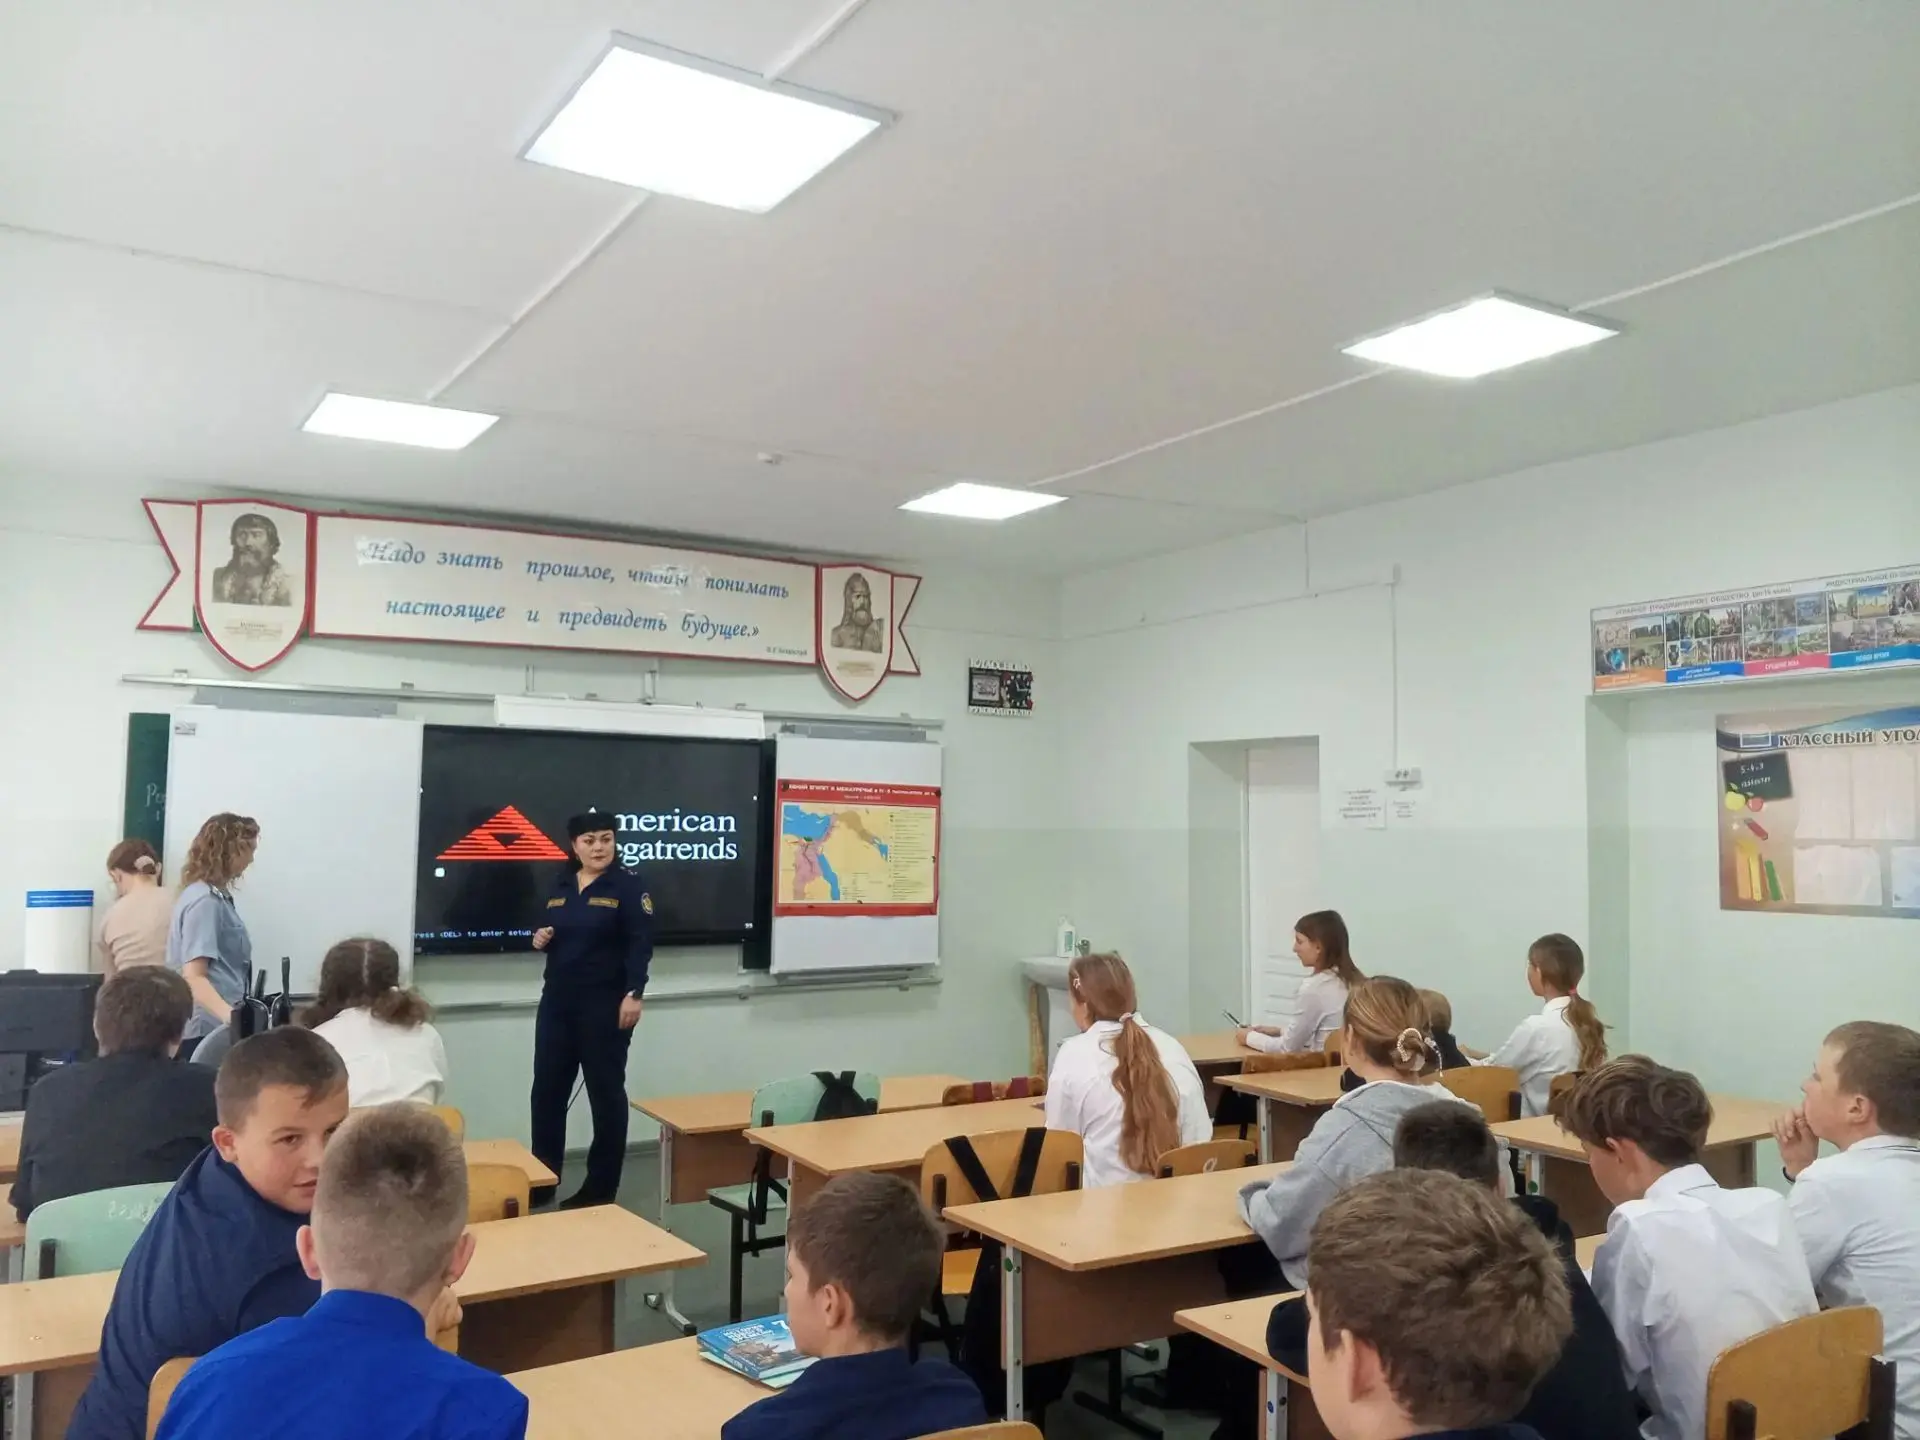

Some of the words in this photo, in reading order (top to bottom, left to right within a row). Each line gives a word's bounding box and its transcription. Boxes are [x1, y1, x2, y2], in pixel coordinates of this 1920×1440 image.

[436, 551, 504, 571] знать
[526, 559, 615, 584] прошлое,
[705, 576, 790, 599] понимать
[386, 599, 507, 624] настоящее
[527, 609, 540, 623] и
[559, 606, 667, 632] предвидеть
[681, 613, 759, 641] будущее.»
[1780, 728, 1873, 747] КЛАССНЫЙ
[588, 806, 737, 833] merican
[413, 931, 435, 939] ress
[440, 930, 462, 938] <DEL>
[481, 929, 504, 937] enter
